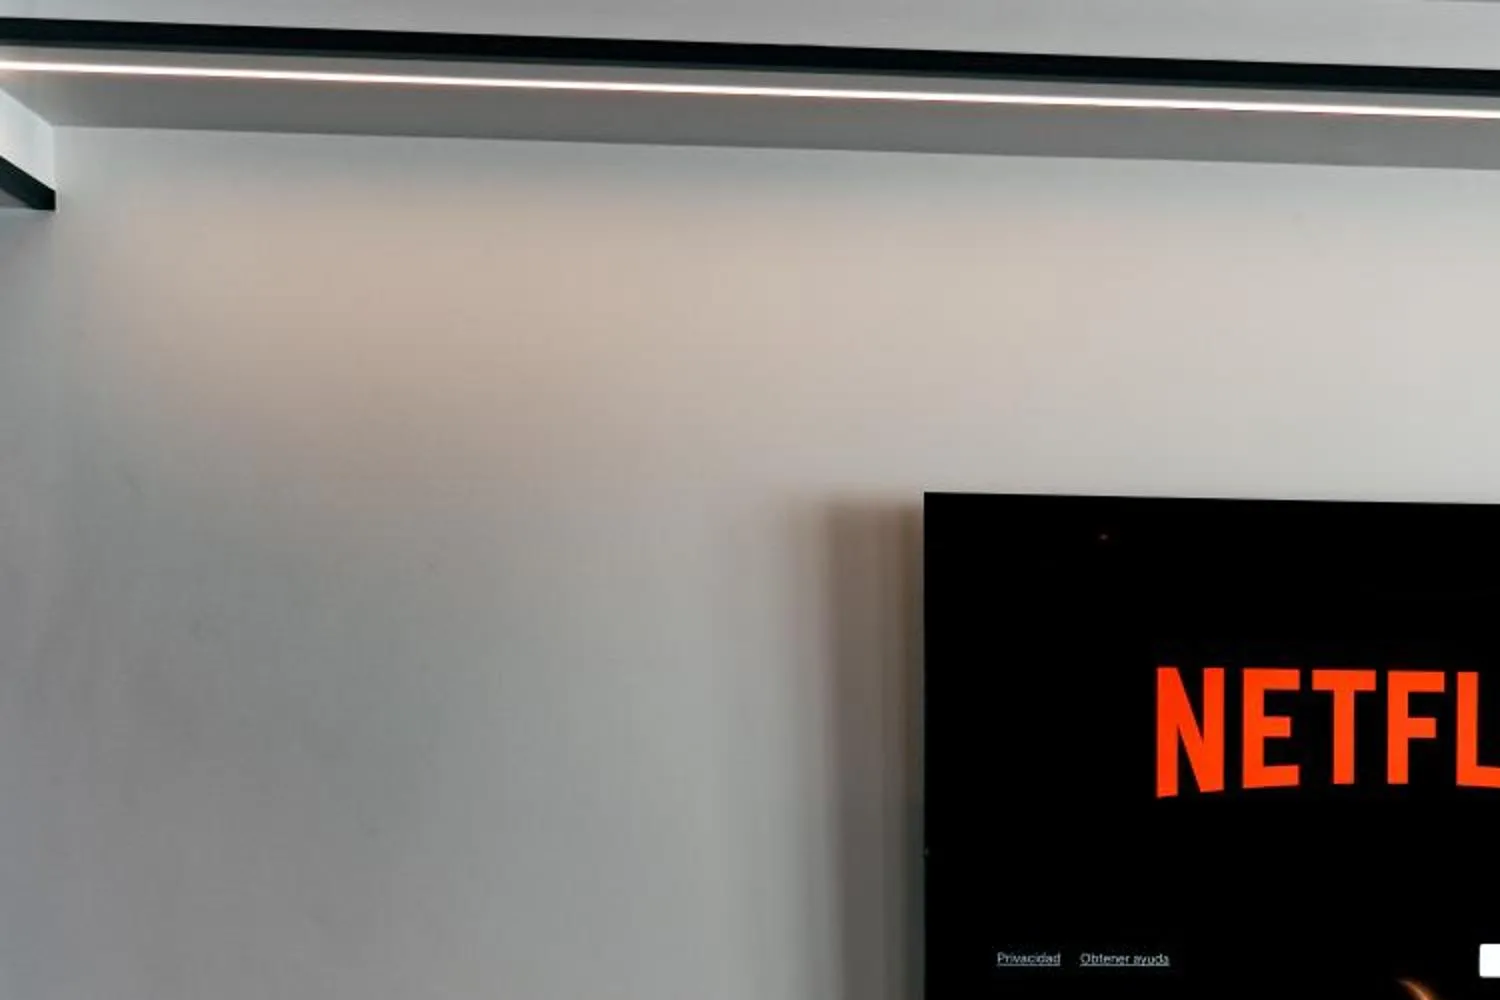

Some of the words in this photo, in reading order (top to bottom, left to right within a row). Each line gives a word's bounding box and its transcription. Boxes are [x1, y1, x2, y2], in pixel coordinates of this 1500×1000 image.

[997, 952, 1061, 967] Privacidad
[1080, 953, 1130, 967] Obtener
[1133, 954, 1170, 967] ayuda
